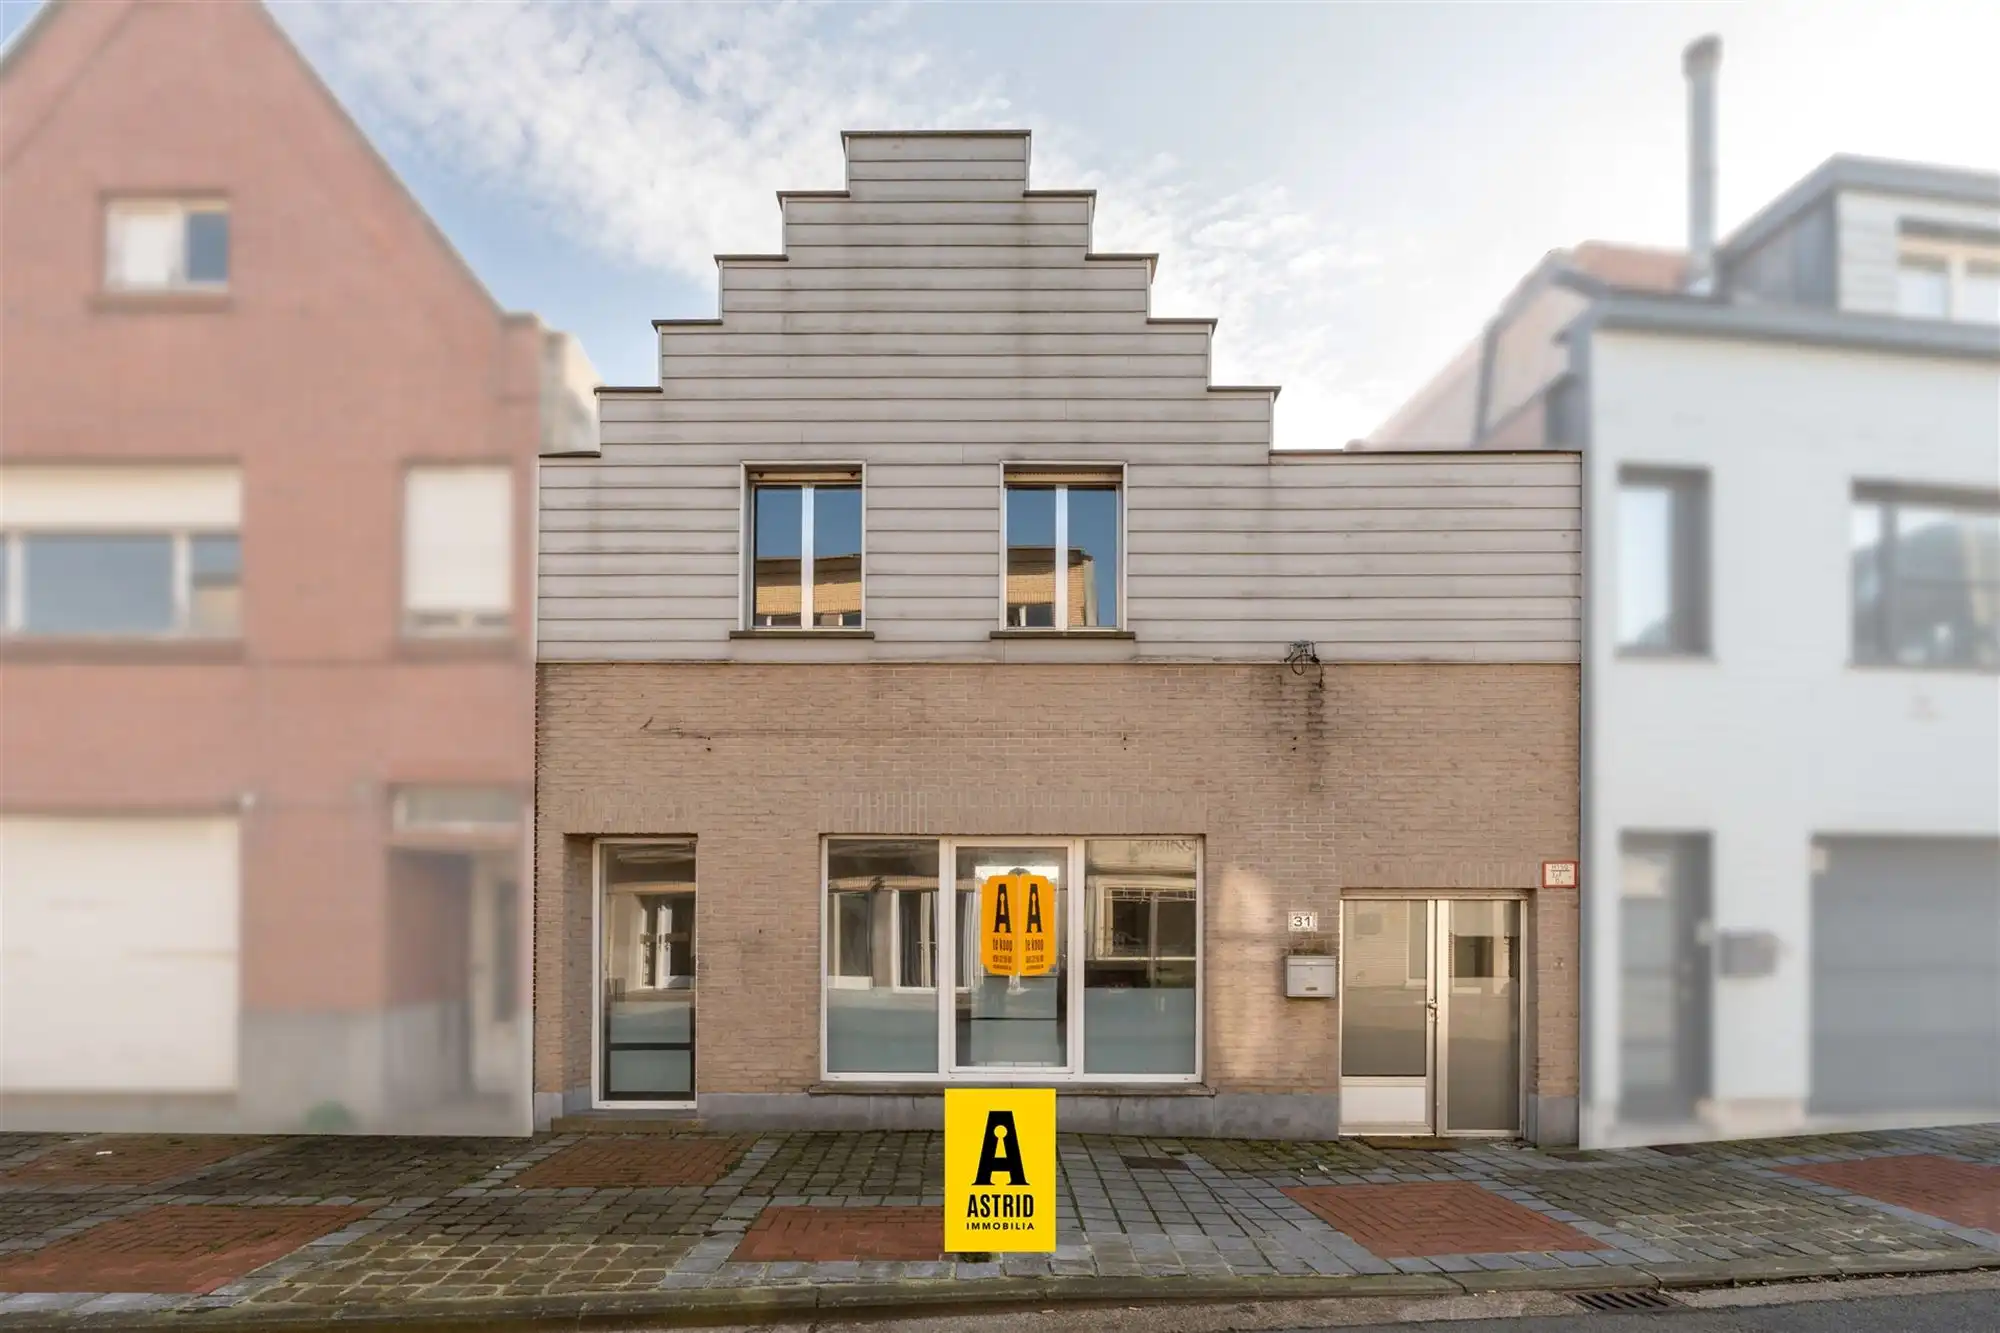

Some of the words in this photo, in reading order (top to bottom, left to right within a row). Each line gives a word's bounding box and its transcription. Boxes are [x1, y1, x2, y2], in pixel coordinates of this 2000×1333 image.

[993, 883, 1012, 933] A
[1025, 883, 1043, 933] A
[1294, 916, 1311, 928] 31
[993, 938, 999, 951] te
[999, 938, 1013, 953] koop
[1025, 938, 1031, 951] te
[1031, 938, 1044, 952] koop
